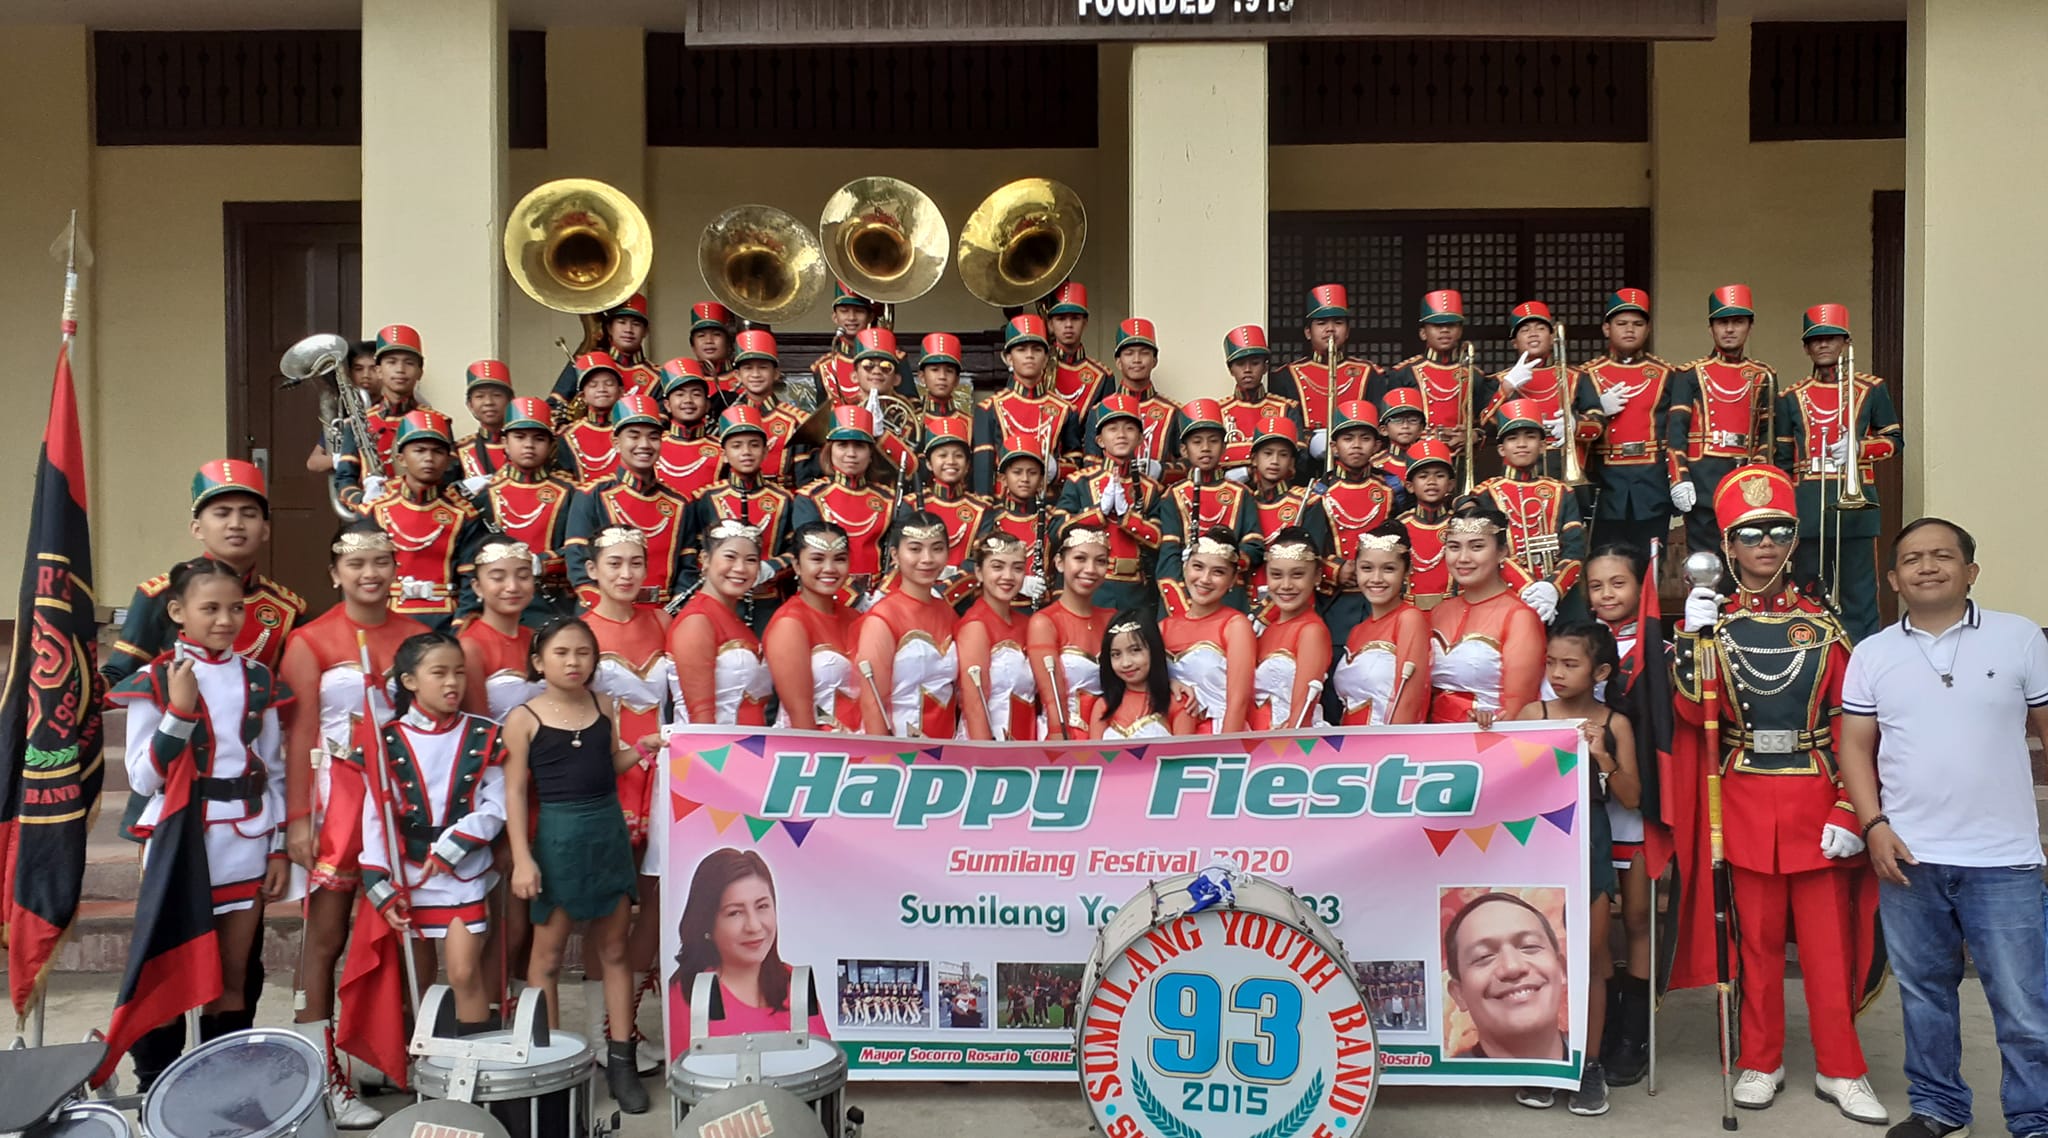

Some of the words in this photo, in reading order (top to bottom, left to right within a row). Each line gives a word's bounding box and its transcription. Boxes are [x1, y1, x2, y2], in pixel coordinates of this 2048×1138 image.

[1079, 0, 1215, 16] FOUNDED
[1760, 734, 1787, 751] 93
[24, 783, 82, 805] BAND
[761, 752, 1102, 831] Happy
[1146, 754, 1483, 818] Fiesta
[949, 849, 1077, 878] Sumilang
[1088, 849, 1199, 874] Festival
[900, 893, 1067, 933] Sumilang
[1084, 915, 1203, 1103] SUMILANG
[1217, 910, 1344, 995] YOUTH
[1327, 1000, 1373, 1117] BAND
[1147, 970, 1304, 1087] 93
[860, 1047, 905, 1064] Mayor
[909, 1048, 962, 1062] Socorro
[966, 1048, 1020, 1062] Rosario
[1379, 1052, 1432, 1067] Rosario
[1182, 1082, 1269, 1116] 2015
